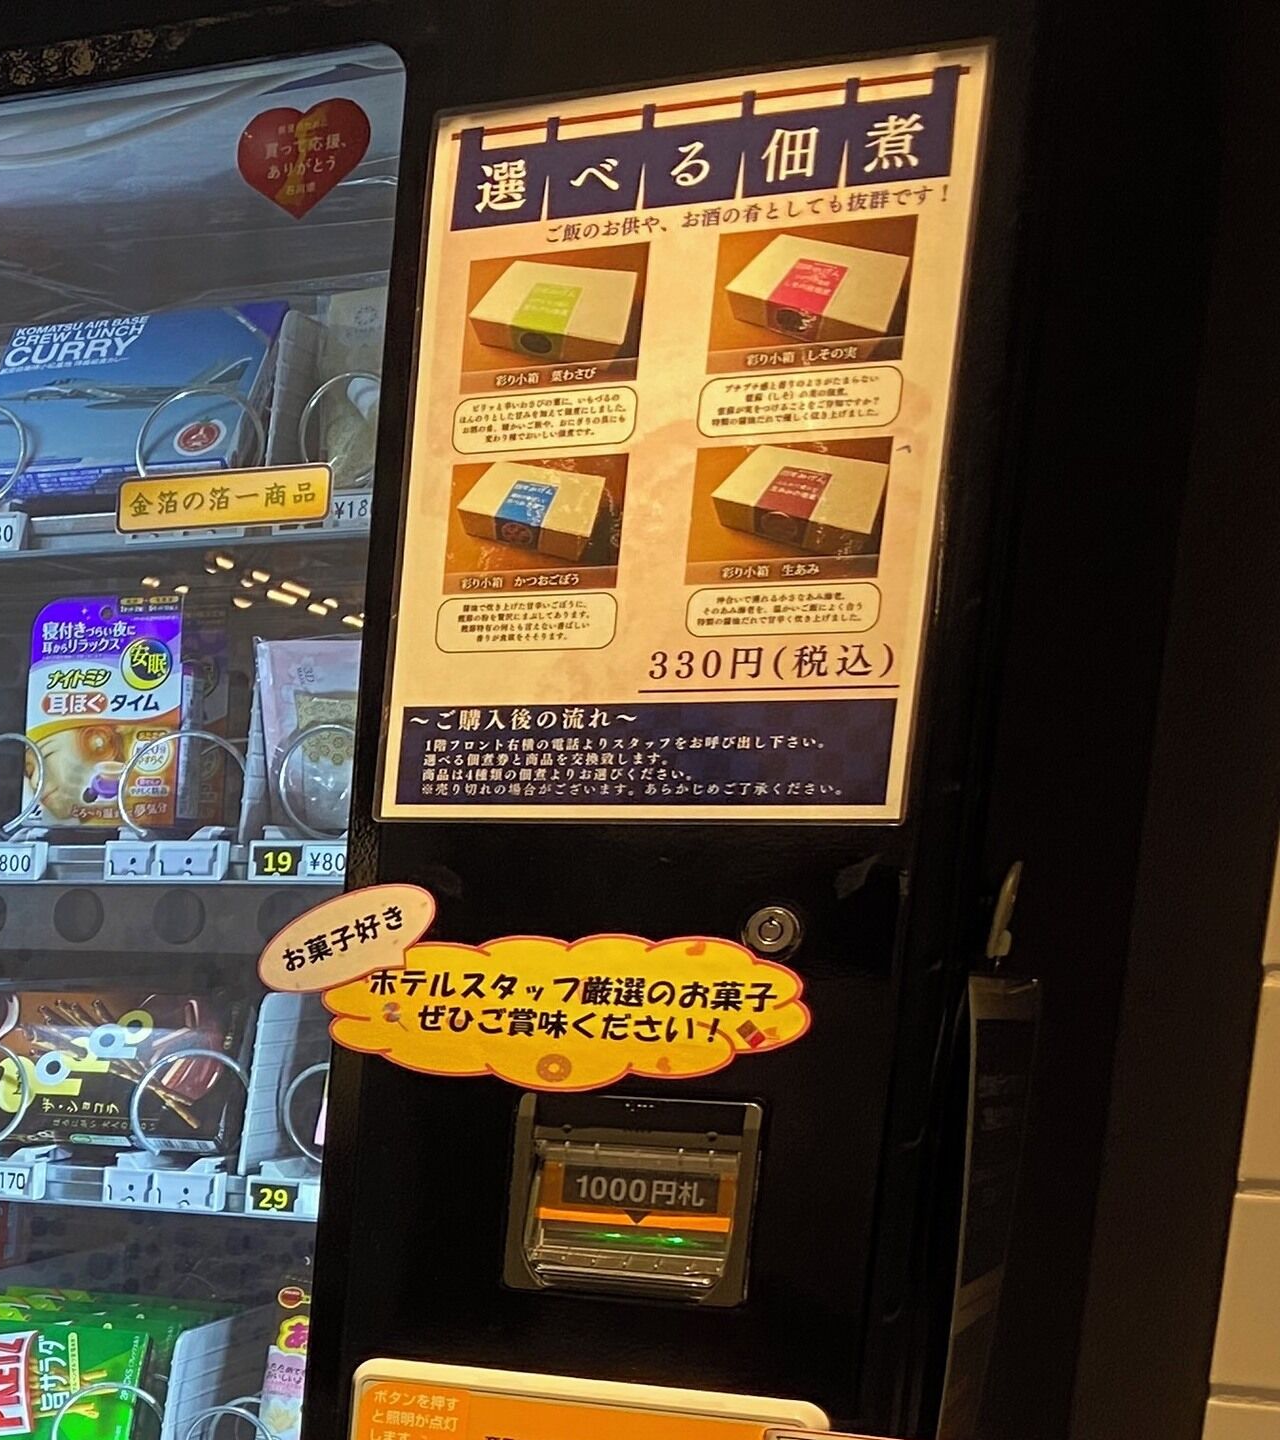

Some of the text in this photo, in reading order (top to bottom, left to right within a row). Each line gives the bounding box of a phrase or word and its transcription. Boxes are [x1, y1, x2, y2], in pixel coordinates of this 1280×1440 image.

[267, 156, 336, 179] ありがとう
[474, 113, 924, 212] 選べる佃煮
[11, 323, 144, 347] CREW LUNCH
[16, 315, 149, 337] KOMATSU AIR BASE
[4, 335, 140, 368] CURRY
[747, 347, 857, 366] 彩り小箱 しその実
[496, 367, 596, 387] 彩り小箱 葉わさび
[129, 481, 316, 518] 金箔の箔一商品
[462, 573, 580, 589] 彩り小箱 かつおごぼう
[721, 563, 820, 579] 彩り小箱 生あみ
[42, 621, 135, 641] 寝付きづらい夜に
[42, 639, 120, 654] 耳からリラックス
[131, 644, 168, 678] 安眠
[649, 644, 897, 681] 330円(税込)
[48, 669, 110, 689] ナイトミン
[47, 693, 160, 715] 耳ほぐタイム
[263, 852, 292, 872] 19
[282, 906, 404, 971] お菓子好き
[369, 968, 778, 1011] ホテルスタッフ厳選のお菓子
[41, 1098, 120, 1114] ザ・ショコラ
[259, 1189, 287, 1209] 29
[575, 1175, 705, 1207] 1000円札
[39, 1335, 70, 1410] 旨サラダ
[374, 1390, 458, 1412] ボタンを押す
[371, 1410, 457, 1432] と照明が点灯
